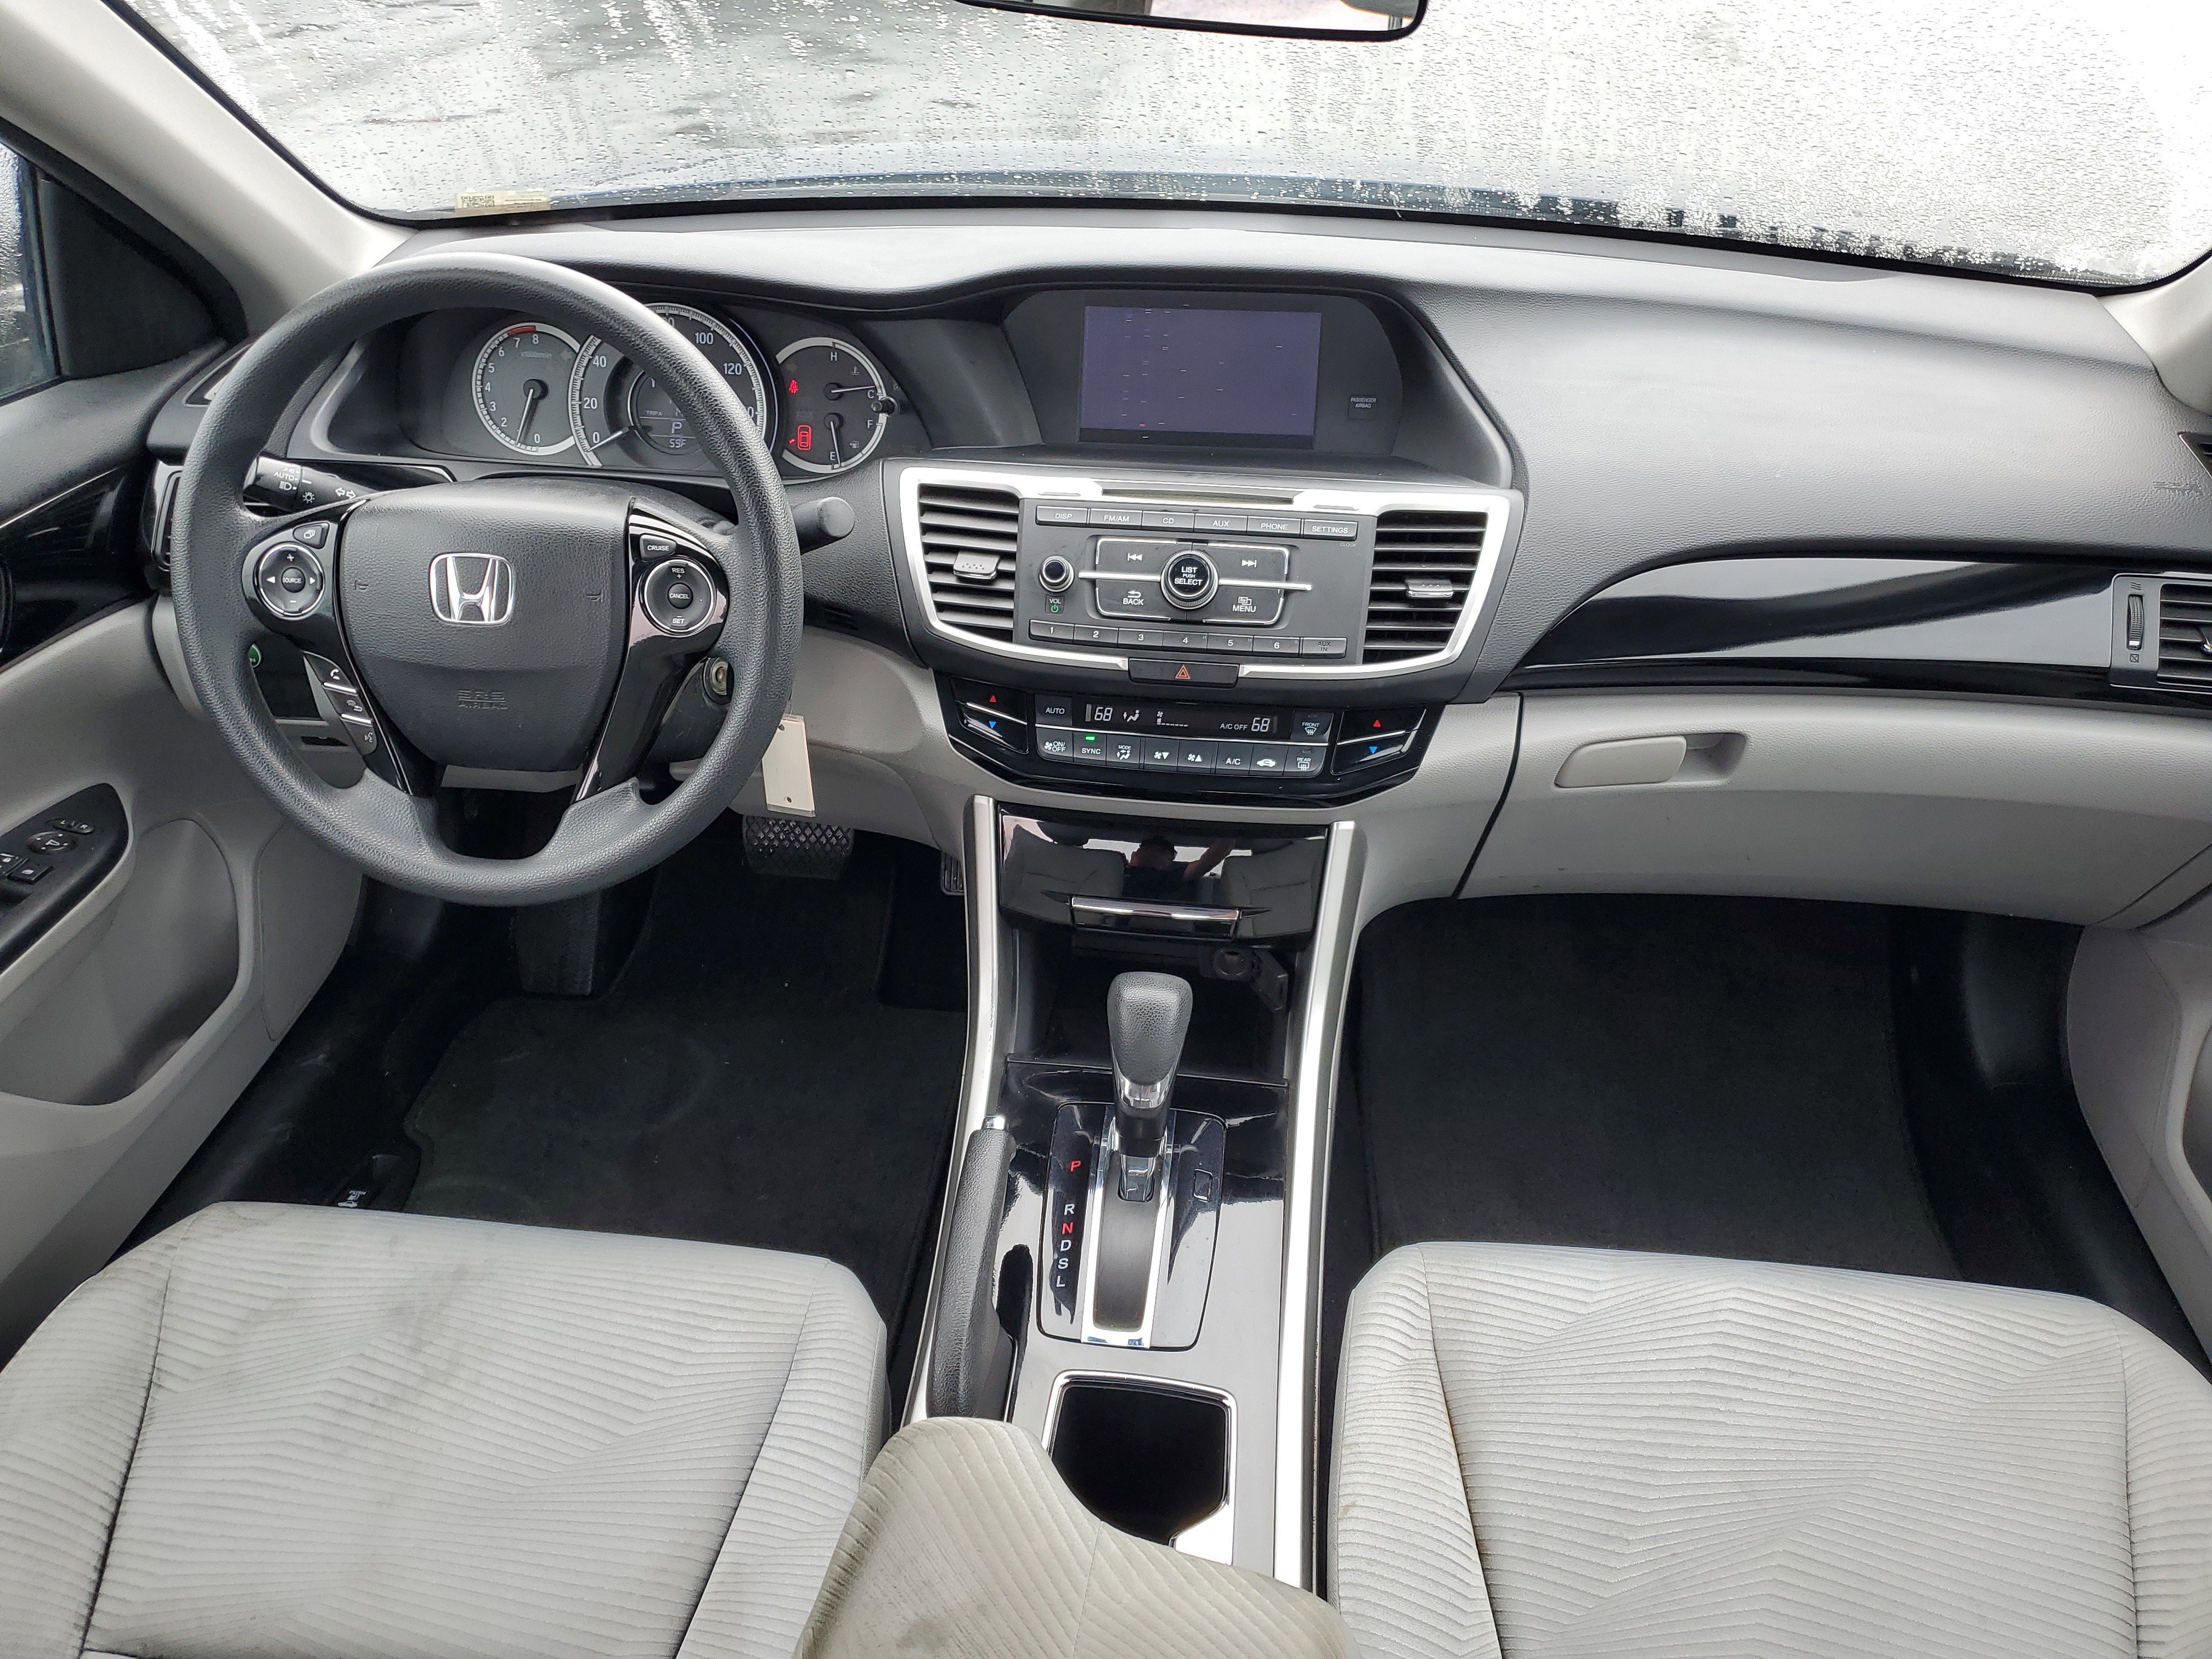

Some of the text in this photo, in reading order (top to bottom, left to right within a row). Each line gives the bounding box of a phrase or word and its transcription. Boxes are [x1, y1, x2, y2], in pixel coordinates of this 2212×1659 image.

[514, 337, 521, 348] 7
[533, 334, 539, 344] 8
[695, 332, 713, 345] 100
[499, 347, 505, 357] 6
[830, 352, 838, 362] H
[593, 356, 607, 368] 40
[489, 363, 495, 373] 5
[723, 362, 742, 375] 120
[484, 382, 491, 392] 4
[867, 390, 874, 399] C
[490, 401, 496, 411] 3
[583, 398, 598, 409] 20
[501, 417, 507, 427] 2
[672, 421, 682, 434] P
[867, 420, 873, 429] F
[534, 433, 540, 443] 0
[592, 432, 600, 443] 0
[830, 451, 836, 460] E
[274, 471, 295, 481] AUTO
[1312, 526, 1348, 534] SETTINGS
[1174, 578, 1203, 586] SELECT
[1094, 707, 1113, 721] 68
[1251, 717, 1271, 732] 68
[1070, 1160, 1081, 1172] P
[1064, 1204, 1075, 1216] R
[1062, 1222, 1074, 1234] N
[1060, 1239, 1071, 1251] D
[1058, 1257, 1069, 1269] S
[1056, 1276, 1065, 1288] L
